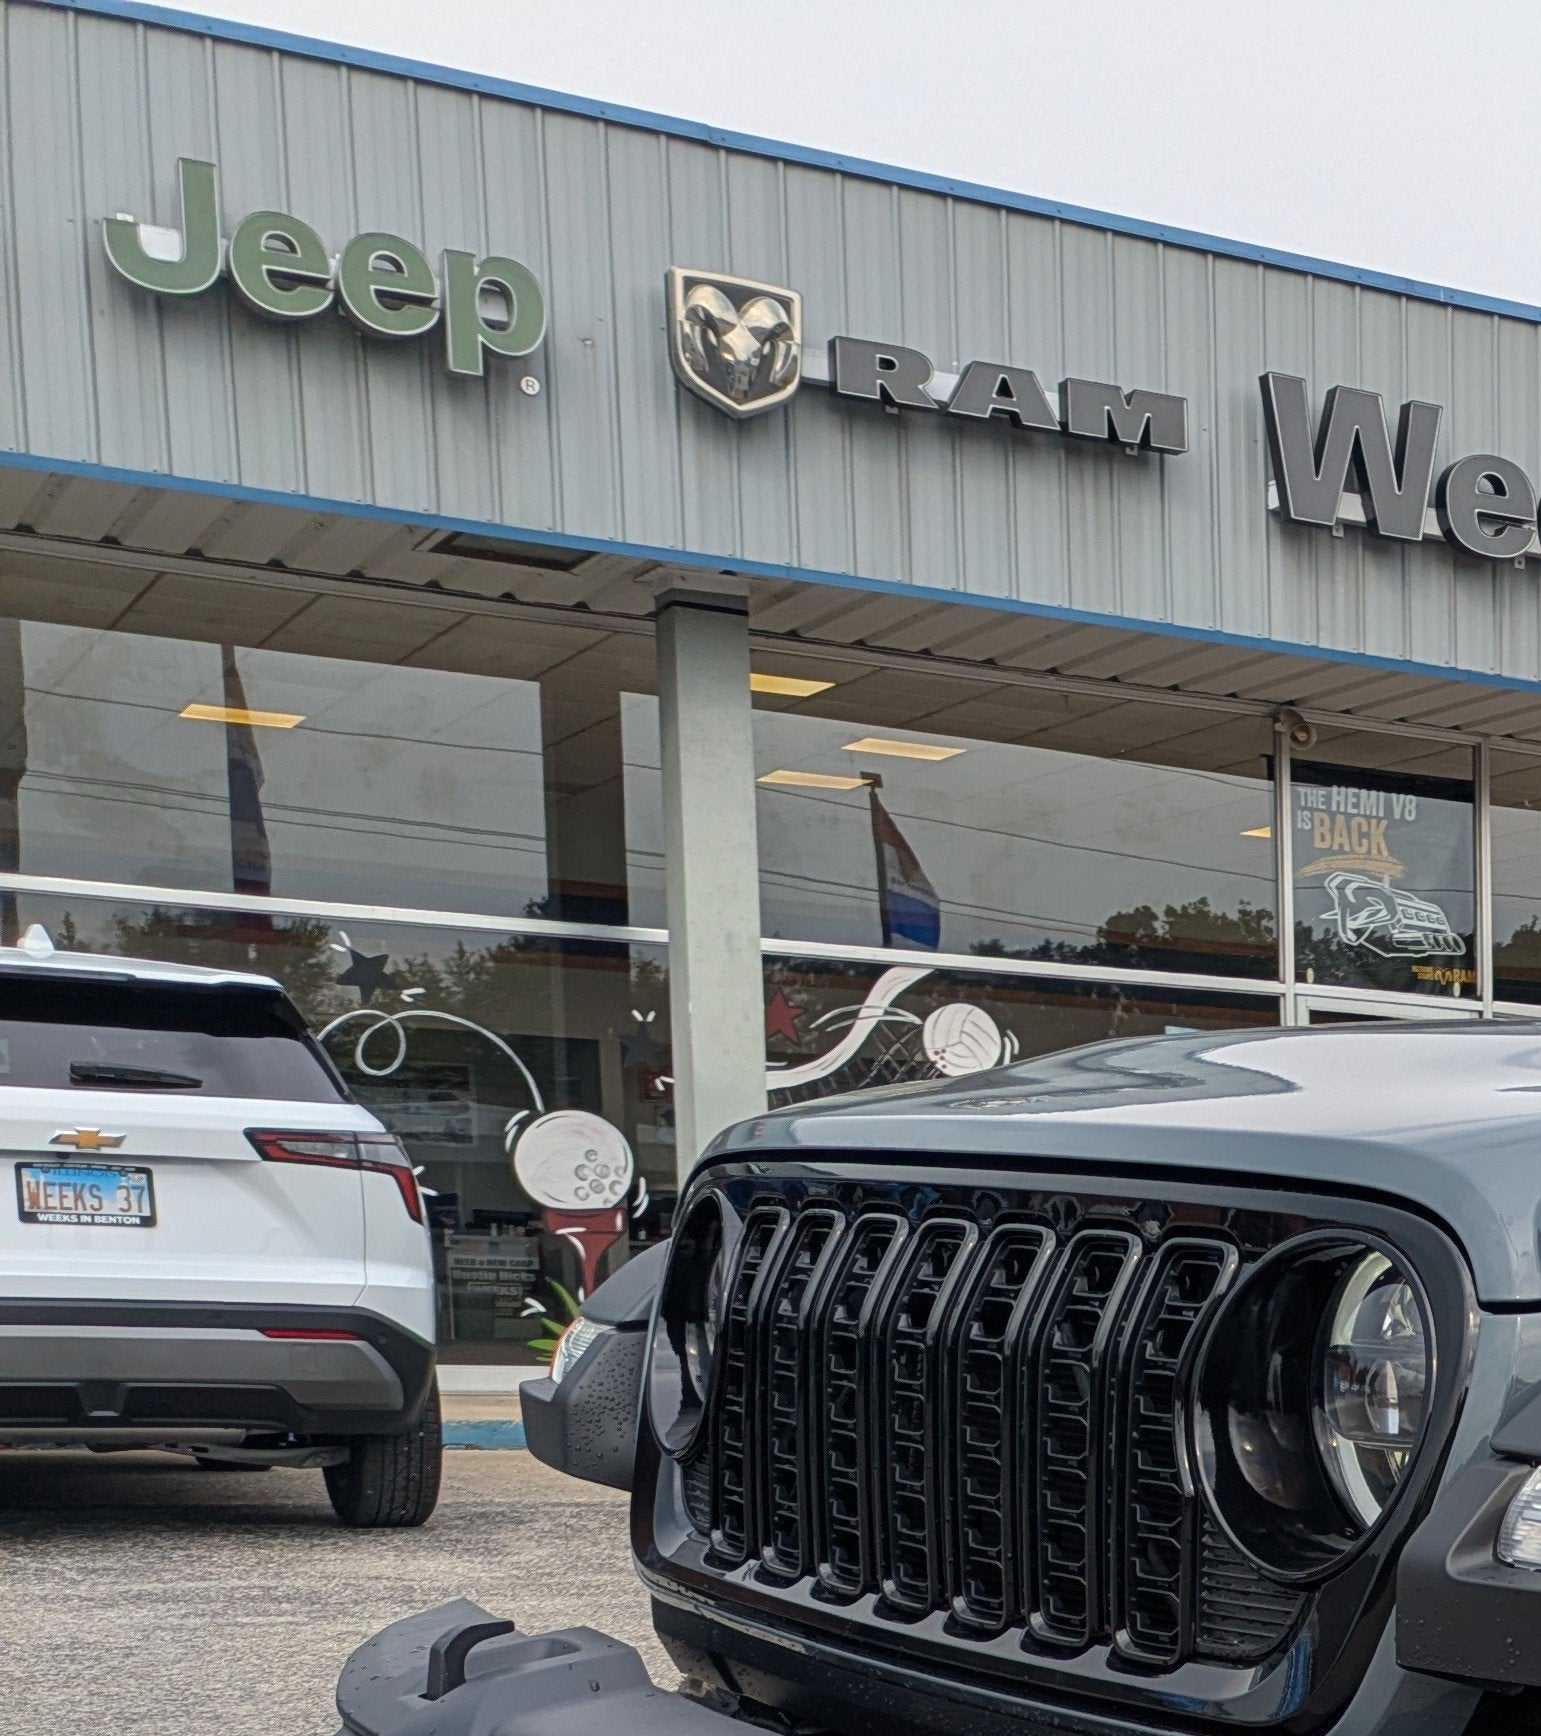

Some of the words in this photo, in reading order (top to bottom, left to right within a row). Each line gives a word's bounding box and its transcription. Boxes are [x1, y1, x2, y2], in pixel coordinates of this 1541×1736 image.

[102, 156, 548, 377] Jeep
[828, 334, 1189, 455] RAM
[1297, 786, 1326, 809] THE
[1331, 785, 1385, 817] HEMI
[1391, 793, 1417, 821] V8
[1297, 809, 1311, 830] IS
[1313, 811, 1389, 857] BACK
[27, 1180, 103, 1211] WEEKS
[117, 1184, 145, 1213] 37
[37, 1213, 78, 1223] WEEKS
[80, 1214, 92, 1223] IN
[94, 1215, 141, 1225] BENTON
